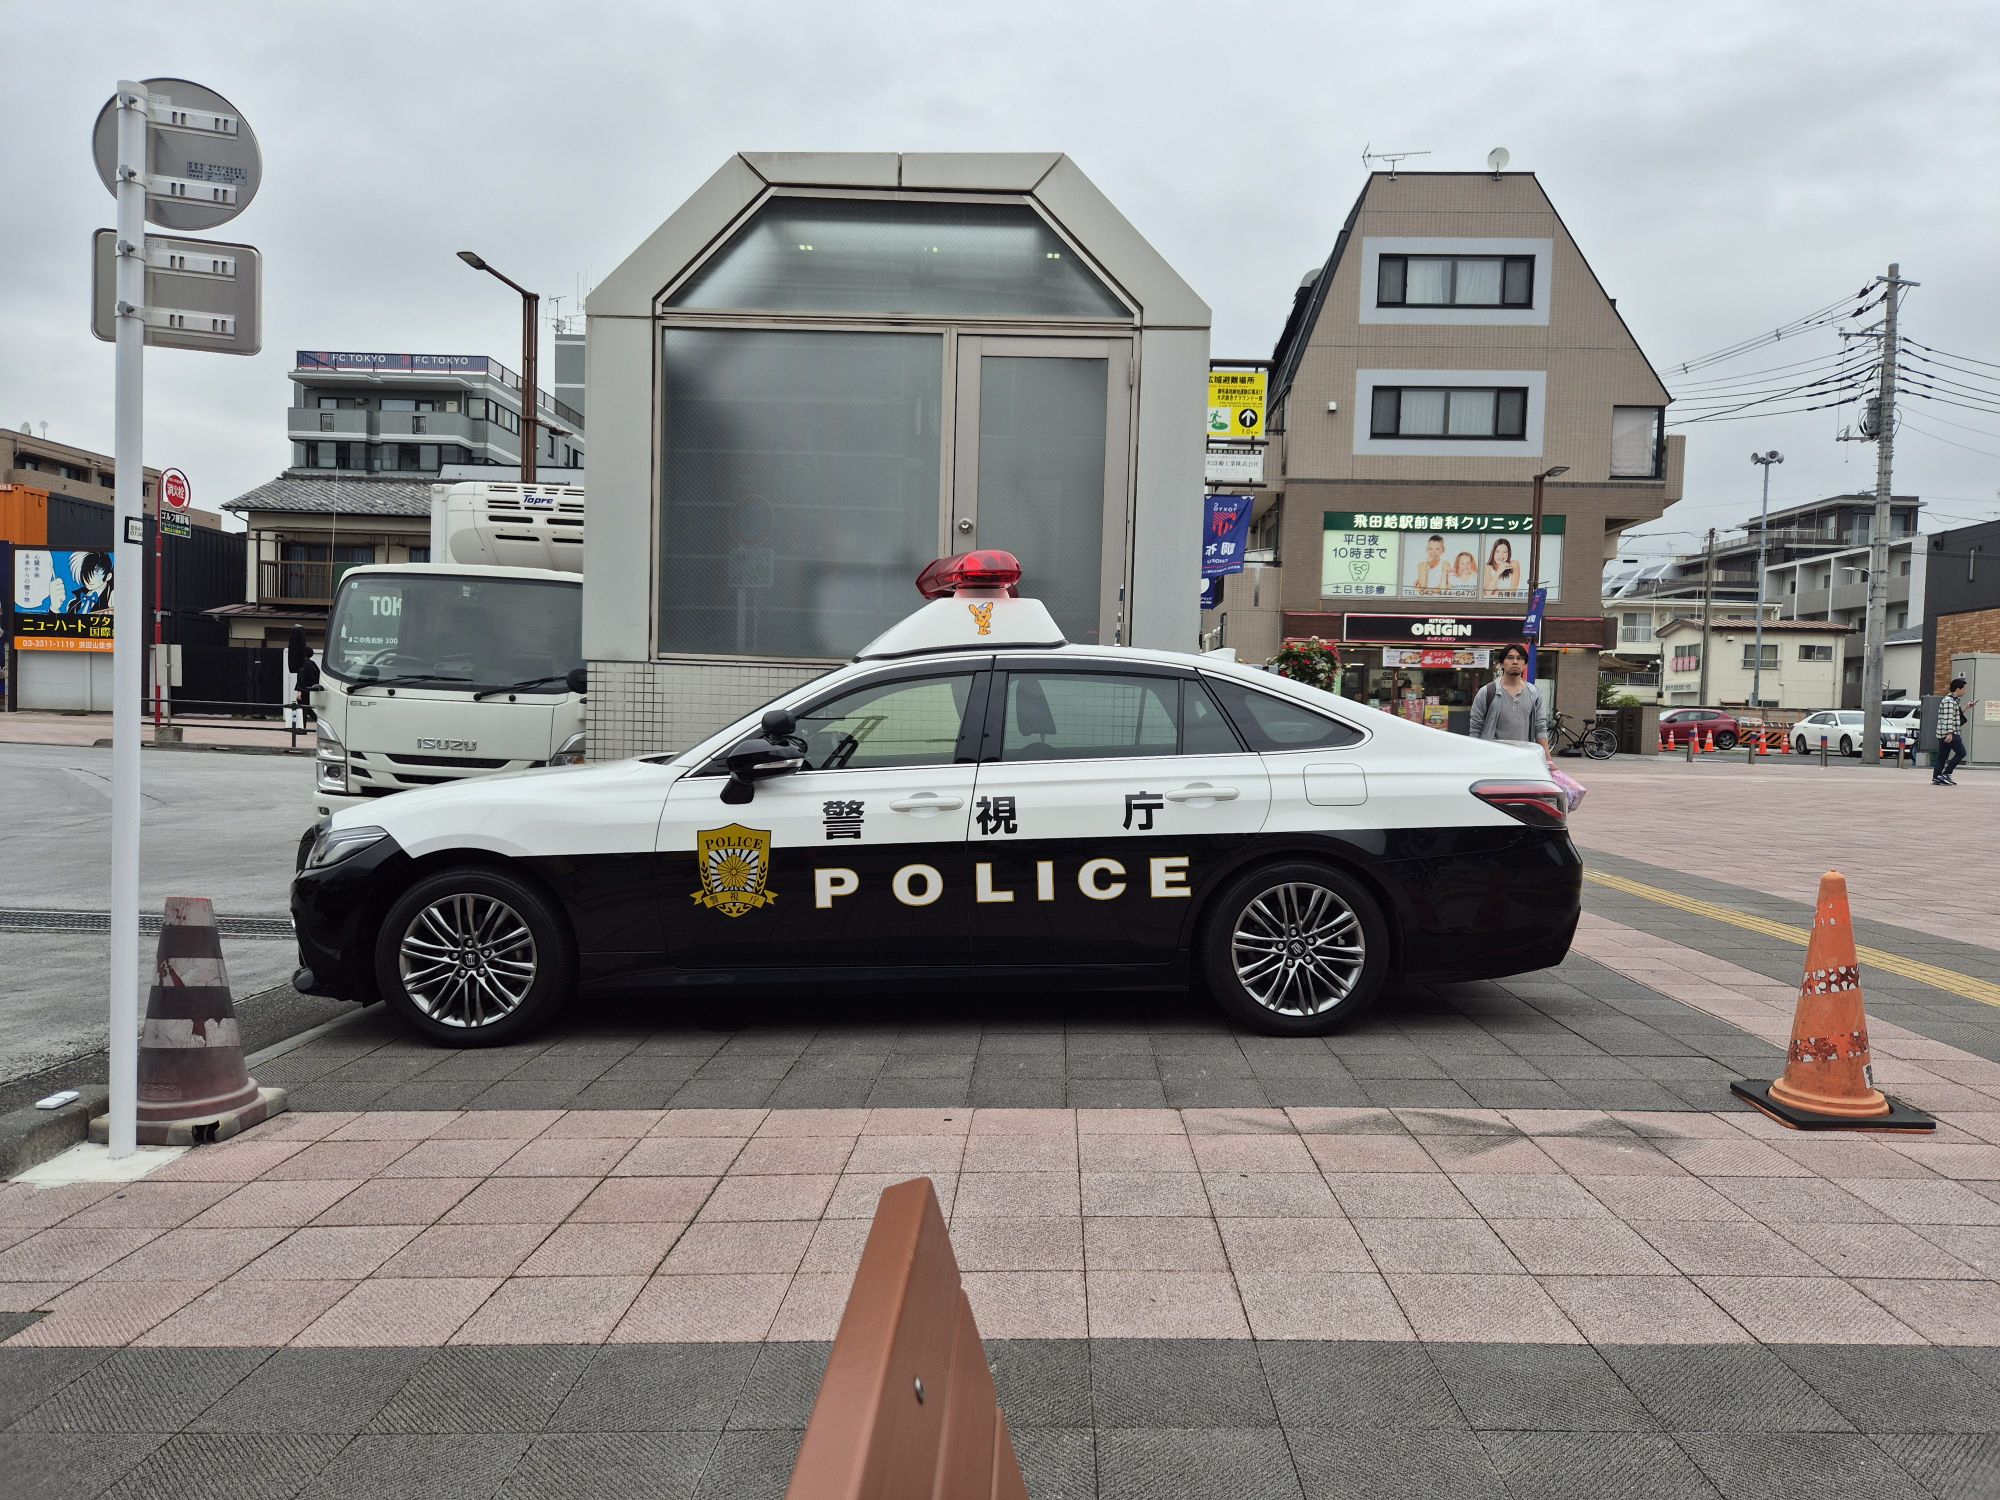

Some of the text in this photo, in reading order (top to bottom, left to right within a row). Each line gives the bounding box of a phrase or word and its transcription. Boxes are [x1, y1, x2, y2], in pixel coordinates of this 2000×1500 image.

[331, 354, 386, 363] FC TOKYO
[415, 356, 469, 365] FC TOKYO
[167, 483, 185, 499] 消火栓
[522, 494, 554, 505] Topre
[1353, 514, 1534, 531] 飛田給駅前歯科クリニック
[1344, 534, 1380, 546] 平日夜
[1332, 547, 1388, 559] 10時まで
[1332, 584, 1386, 595] 土日も診療
[1419, 589, 1476, 597] 042-444-6479
[22, 618, 87, 633] ニューハート
[1411, 623, 1472, 637] ORIGIN
[89, 627, 115, 638] 国際
[22, 639, 75, 649] 03-3311-1119
[349, 700, 377, 708] ELF
[416, 737, 478, 752] ISUZU
[704, 836, 763, 850] POLICE
[813, 856, 1193, 910] POLICE
